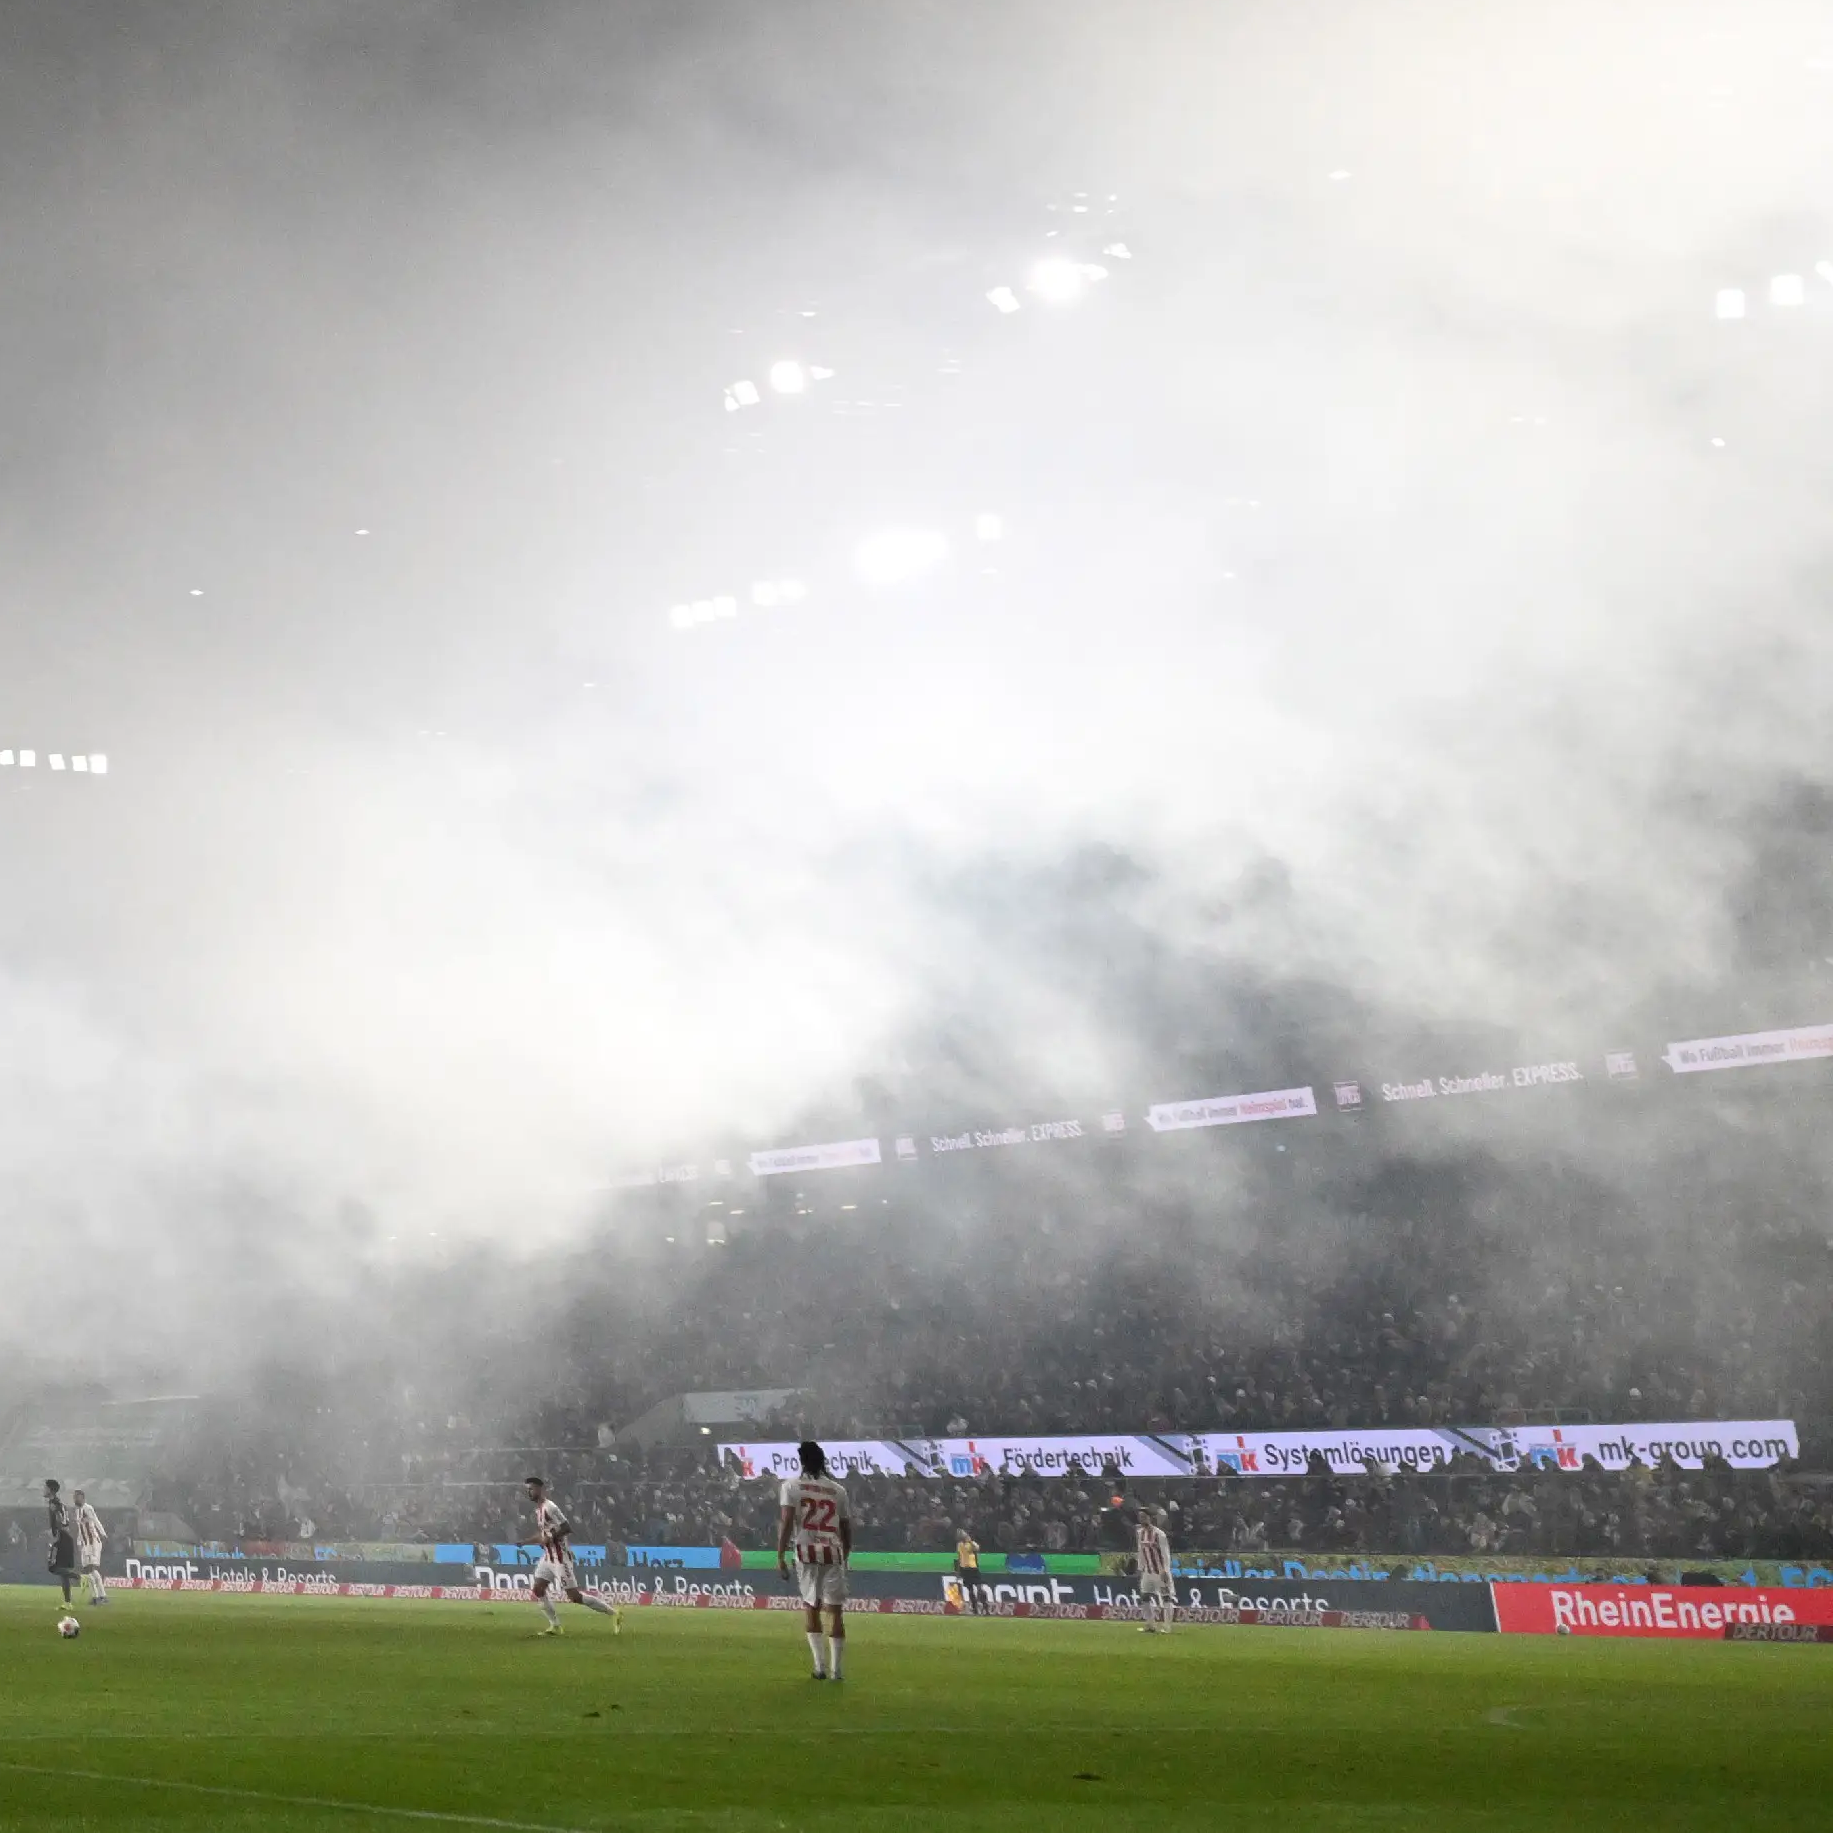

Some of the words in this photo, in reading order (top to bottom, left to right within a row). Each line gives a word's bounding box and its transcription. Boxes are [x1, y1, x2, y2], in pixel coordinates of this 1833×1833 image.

[1382, 1079, 1436, 1101] Schnell.
[1439, 1072, 1510, 1095] Schneller.
[1512, 1062, 1584, 1088] EXPRESS.
[1004, 1446, 1133, 1469] Fördertechnik
[1598, 1435, 1789, 1464] mk-group.com
[800, 1497, 837, 1532] 22
[209, 1563, 257, 1583] Hotels
[277, 1566, 337, 1584] Resorts
[585, 1574, 646, 1594] Hotels
[675, 1576, 754, 1596] Resorts
[180, 1579, 213, 1591] DERTOUR
[220, 1580, 255, 1592] DERTOUR
[261, 1581, 295, 1593] DERTOUR
[303, 1582, 339, 1595] DERTOUR
[349, 1583, 386, 1596] DERTOUR
[393, 1584, 431, 1598] DERTOUR
[440, 1585, 481, 1599] DERTOUR
[651, 1593, 698, 1607] DERTOUR
[708, 1595, 756, 1608] DERTOUR
[893, 1598, 945, 1614] DERTOUR
[1028, 1603, 1087, 1619] DERTOUR
[1176, 1607, 1239, 1623] DERTOUR
[1258, 1610, 1323, 1626] DERTOUR
[1340, 1611, 1409, 1628] DERTOUR
[1733, 1624, 1819, 1641] DERTOUR
[1550, 1590, 1795, 1630] RheinEnergie
